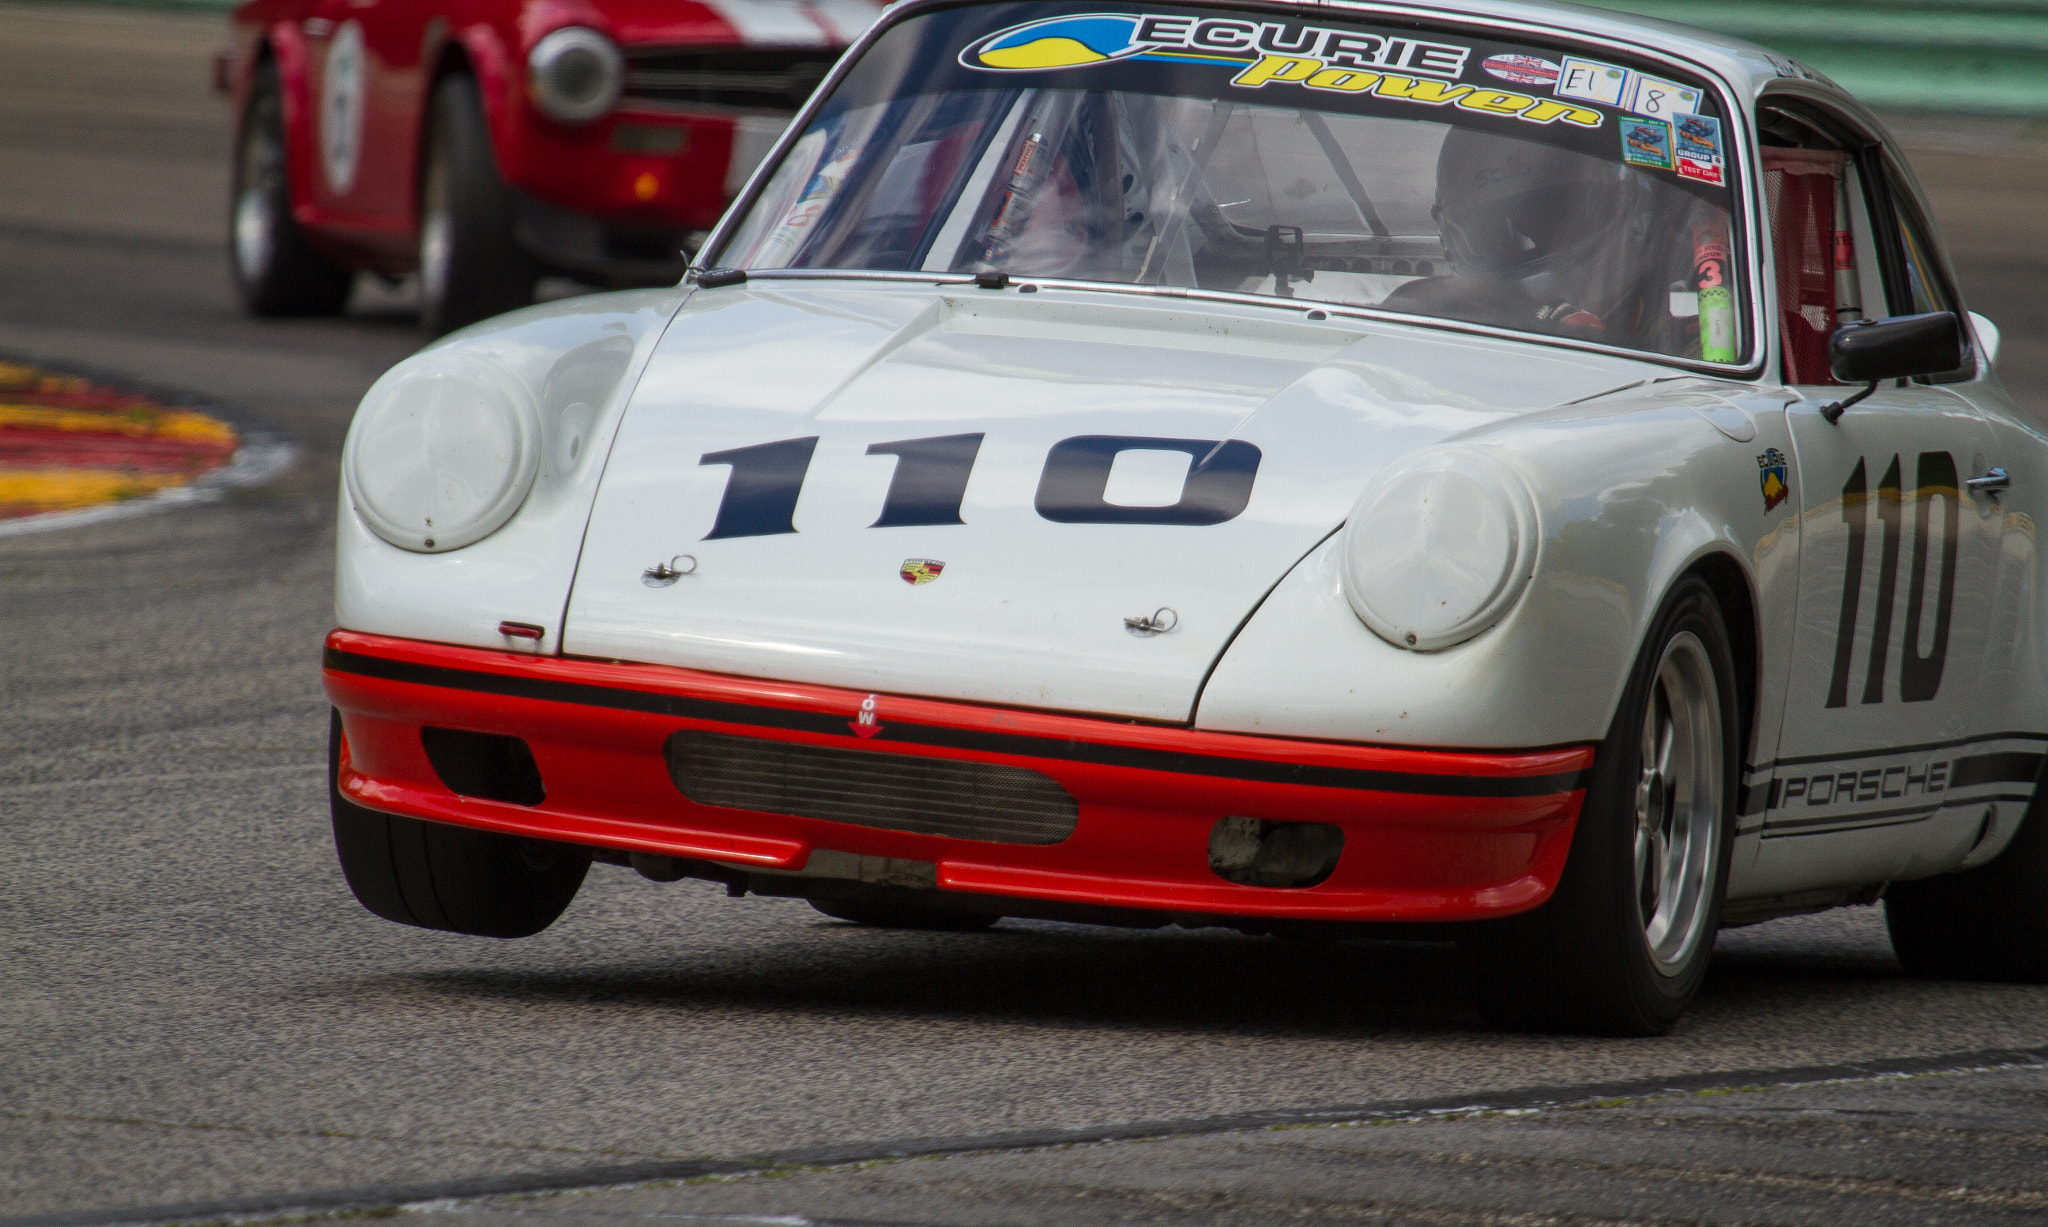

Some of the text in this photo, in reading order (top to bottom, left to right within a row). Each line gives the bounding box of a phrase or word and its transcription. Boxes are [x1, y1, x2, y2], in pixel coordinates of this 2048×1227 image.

[1129, 14, 1471, 78] ECURIE
[1230, 53, 1604, 128] power
[1645, 89, 1666, 114] 8
[1677, 147, 1711, 161] GROUP
[1683, 165, 1701, 175] TEST
[1698, 260, 1722, 289] 3
[699, 432, 1262, 541] 110
[1824, 451, 1958, 708] 110
[1780, 761, 1949, 808] PORSCHE
